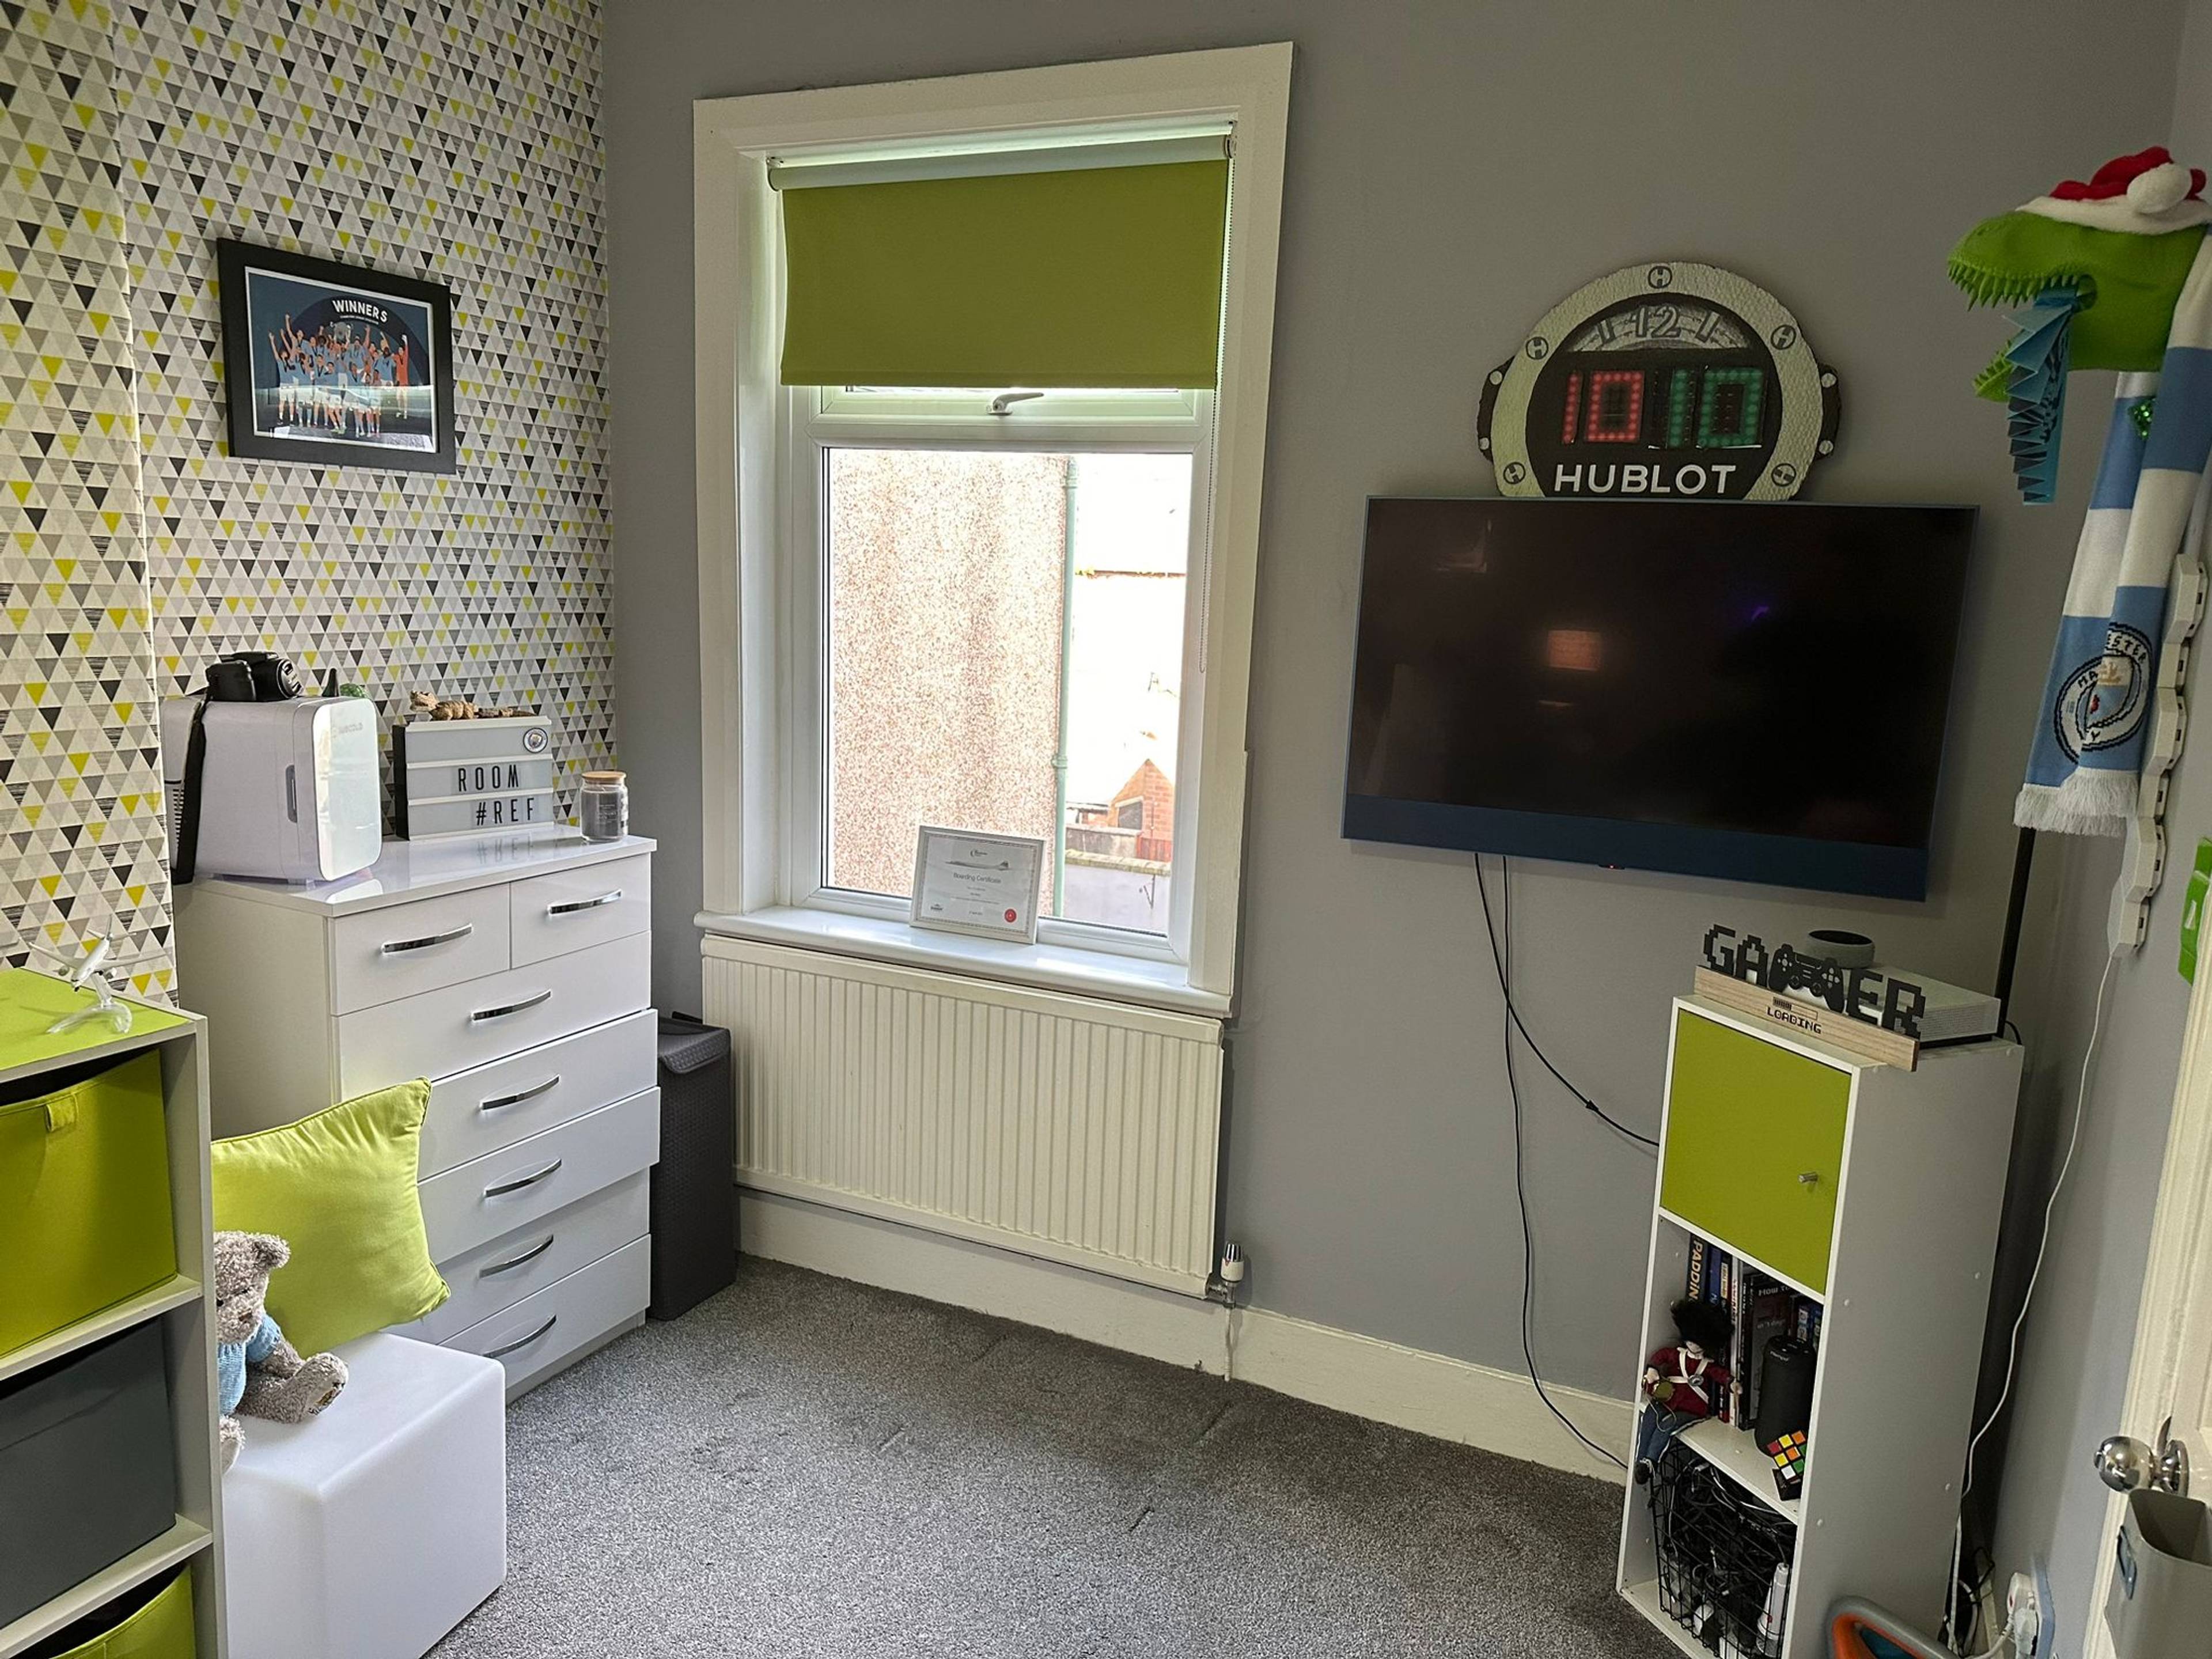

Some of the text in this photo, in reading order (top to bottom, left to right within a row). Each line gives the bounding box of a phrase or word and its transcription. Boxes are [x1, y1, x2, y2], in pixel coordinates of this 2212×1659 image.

[332, 300, 388, 323] WINNERS
[1635, 305, 1681, 339] 12
[1562, 367, 1764, 448] 10 10
[1554, 464, 1737, 495] HUBLOT
[458, 764, 518, 792] ROOM
[476, 797, 535, 826] #REF
[1766, 1006, 1822, 1035] LOADING
